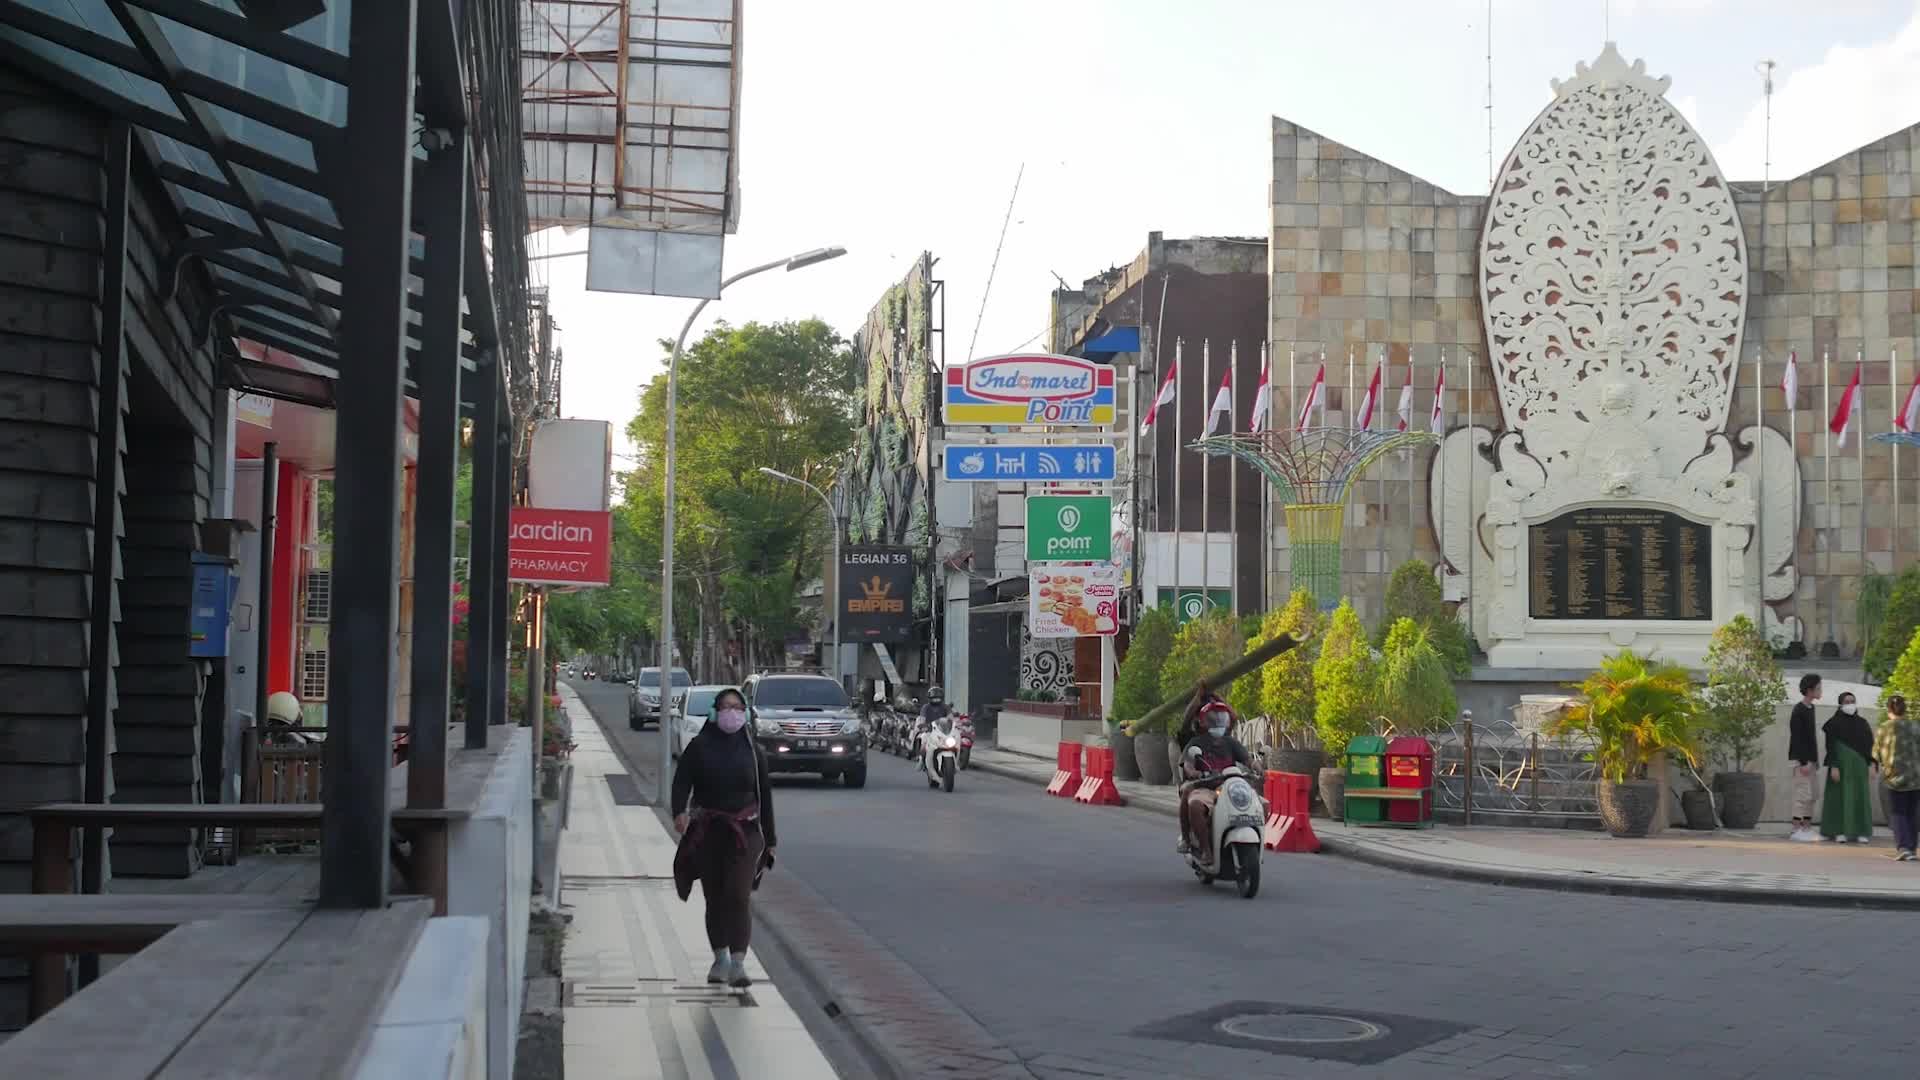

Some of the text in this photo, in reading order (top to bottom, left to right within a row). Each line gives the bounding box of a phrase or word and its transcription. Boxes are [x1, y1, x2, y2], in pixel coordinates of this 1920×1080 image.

[975, 367, 1088, 390] Indomaret
[1028, 399, 1094, 421] Point
[509, 520, 593, 542] uardian
[510, 558, 588, 573] PHARMACY
[844, 553, 907, 564] LEGIAN 36
[1034, 617, 1057, 625] Fried
[1034, 625, 1070, 634] Chicken
